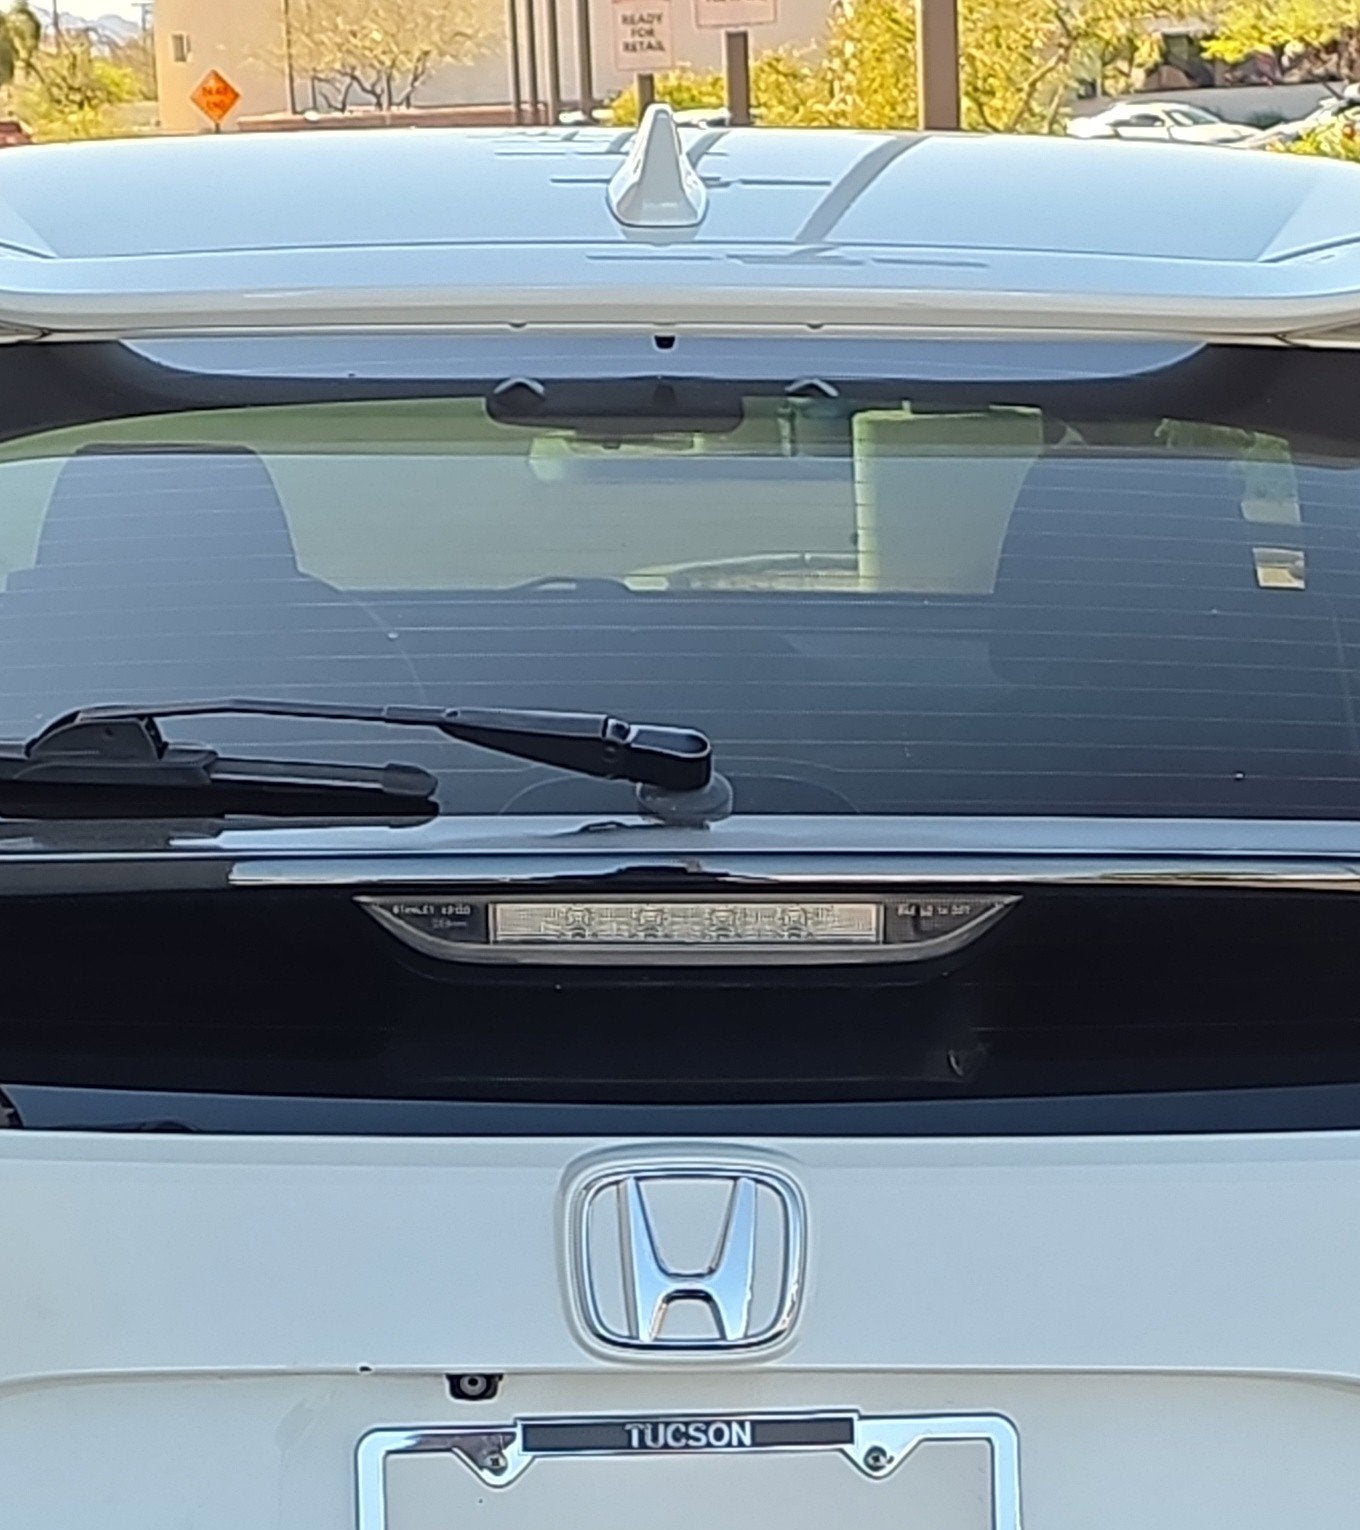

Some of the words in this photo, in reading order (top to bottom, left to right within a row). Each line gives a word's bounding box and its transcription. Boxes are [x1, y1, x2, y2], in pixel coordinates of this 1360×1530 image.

[621, 12, 663, 25] READY
[630, 27, 655, 38] FOR
[623, 1421, 753, 1450] TUCSON
